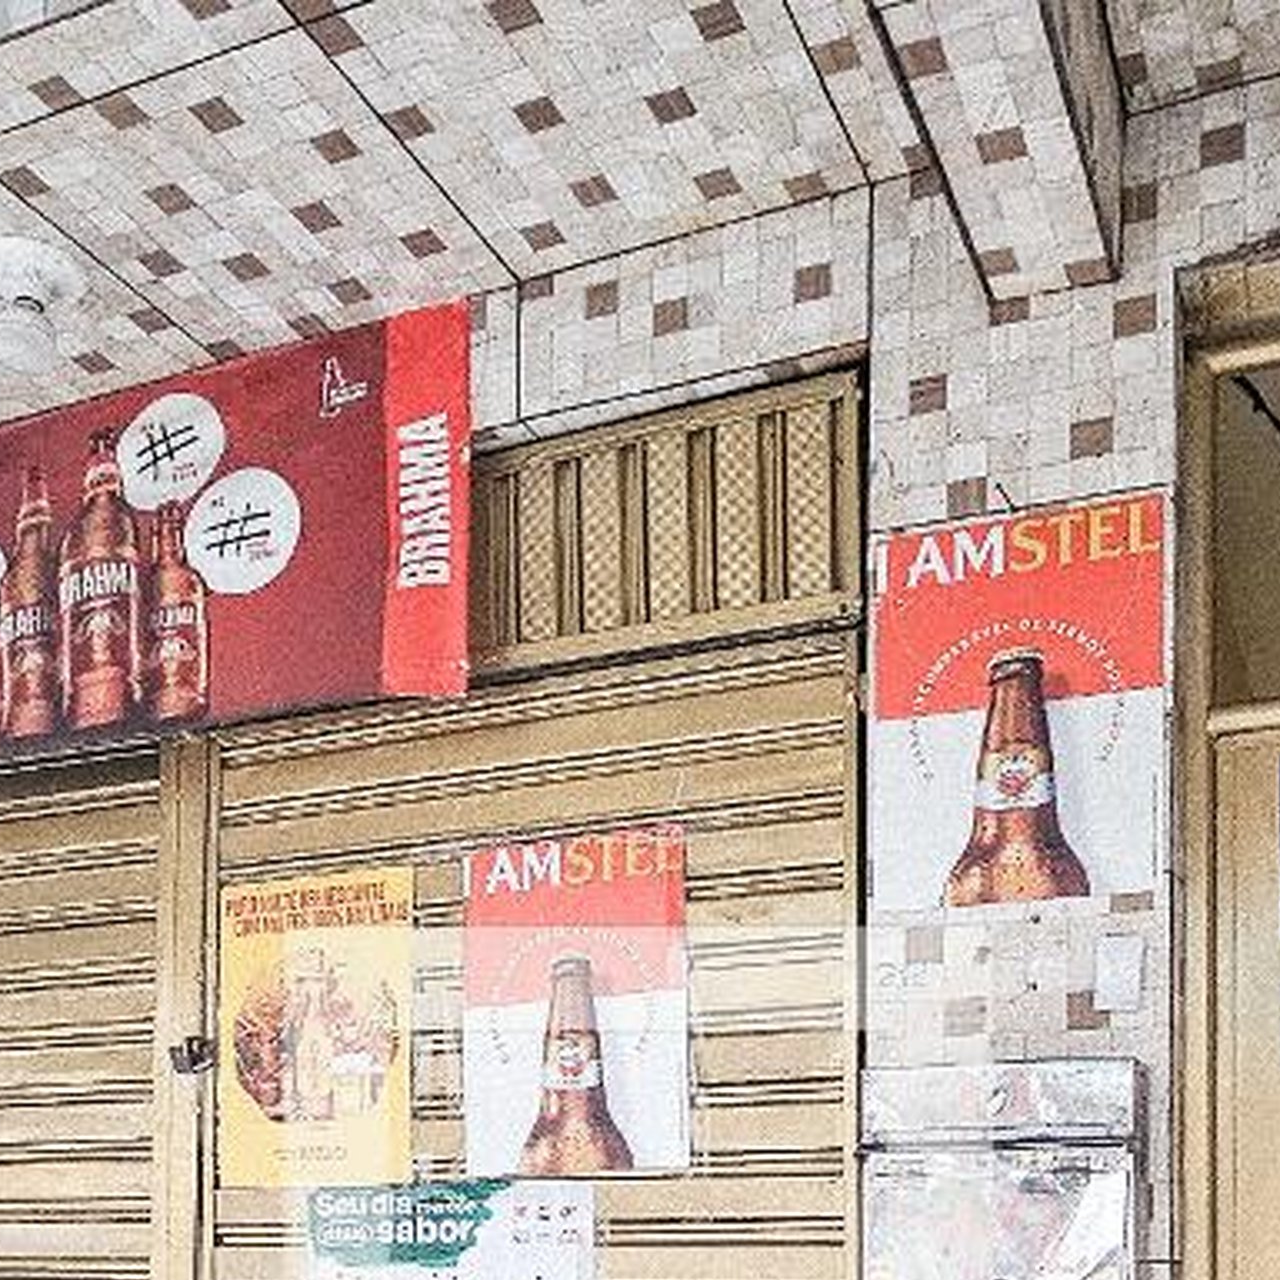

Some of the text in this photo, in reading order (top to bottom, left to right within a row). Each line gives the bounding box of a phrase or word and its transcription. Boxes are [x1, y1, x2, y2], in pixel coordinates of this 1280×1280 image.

[396, 411, 450, 590] BRAHMA
[906, 501, 1161, 589] AMSTEL
[485, 826, 684, 896] AMSTEL
[376, 1218, 477, 1245] sabor
